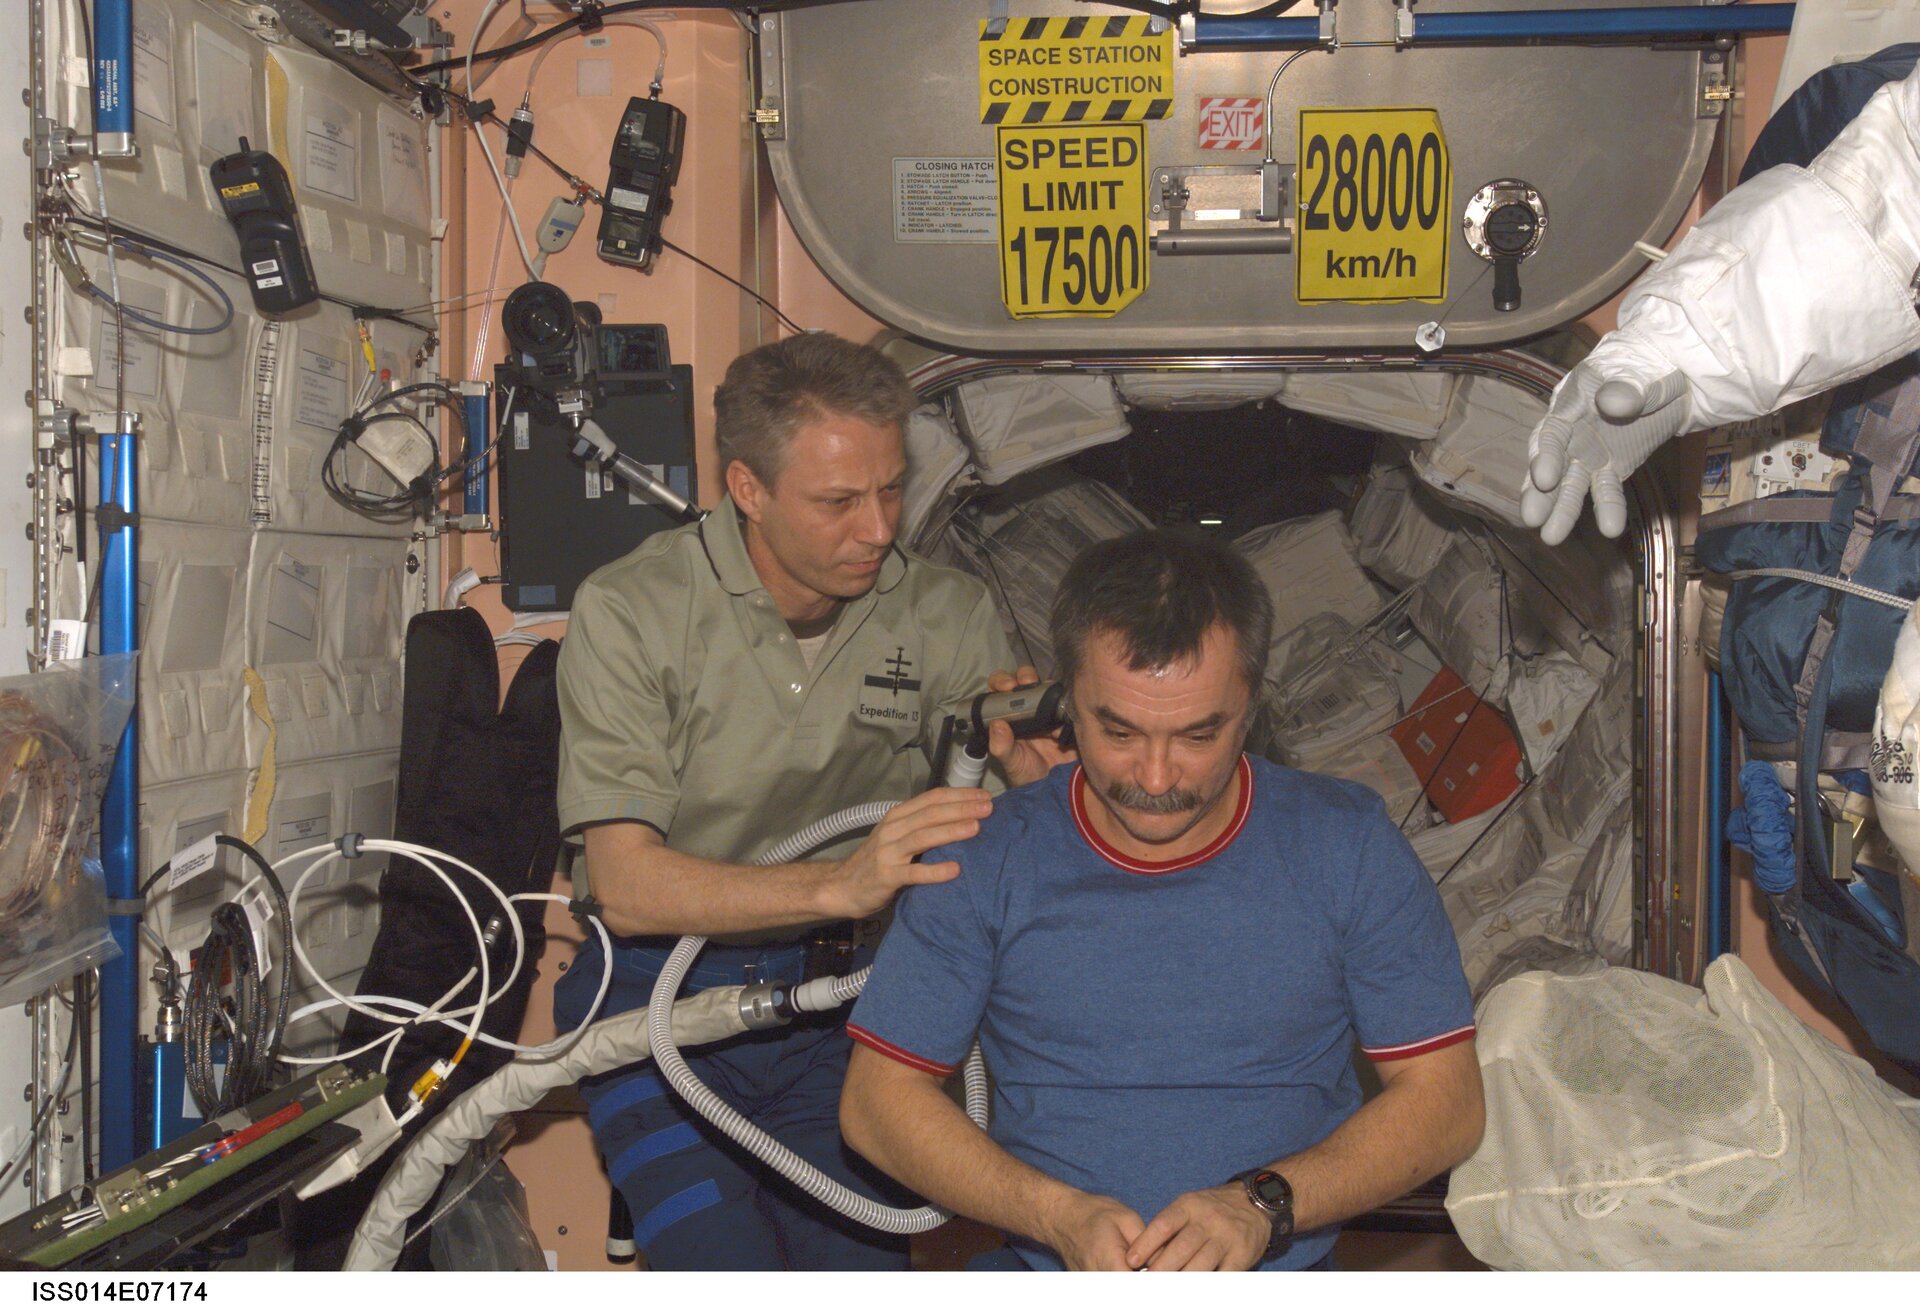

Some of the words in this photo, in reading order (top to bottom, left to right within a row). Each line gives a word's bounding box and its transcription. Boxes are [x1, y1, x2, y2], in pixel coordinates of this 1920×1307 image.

[988, 47, 1061, 66] SPACE
[1068, 45, 1161, 64] STATION
[988, 75, 1162, 96] CONSTRUCTION
[1208, 109, 1253, 138] EXIT
[915, 162, 958, 171] CLOSING
[960, 162, 994, 171] HATCH
[1004, 136, 1138, 170] SPEED
[1022, 179, 1124, 212] LIMIT
[1304, 131, 1442, 233] 28000
[1010, 223, 1139, 306] 17500
[1325, 248, 1417, 279] km/h
[860, 703, 908, 720] Expedition
[911, 711, 919, 722] 13
